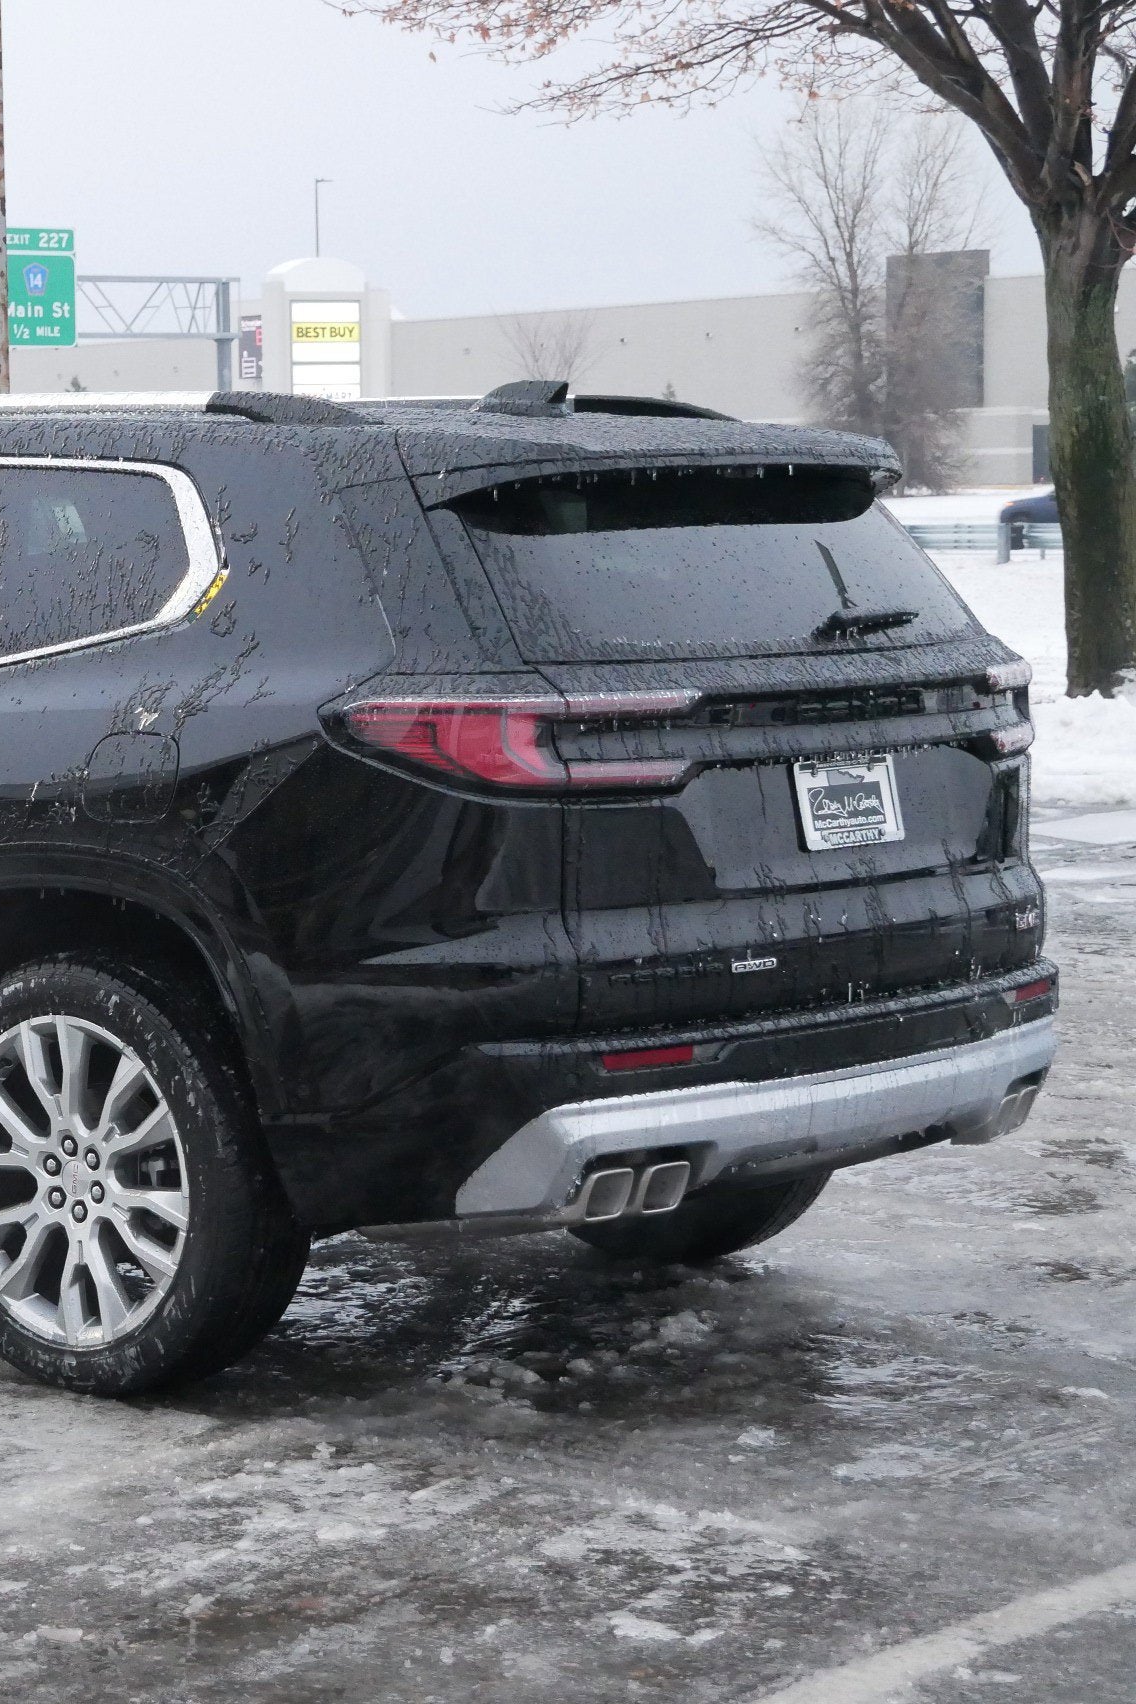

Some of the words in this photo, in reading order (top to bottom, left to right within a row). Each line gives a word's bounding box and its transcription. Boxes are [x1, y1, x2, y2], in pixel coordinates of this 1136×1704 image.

[6, 233, 30, 245] EXIT
[38, 232, 69, 248] 227
[29, 273, 43, 288] 14
[52, 301, 70, 318] St
[36, 326, 61, 337] MILE
[296, 326, 327, 338] BEST
[329, 326, 355, 338] BUY
[814, 815, 884, 829] McCarthyauto.com
[829, 828, 880, 846] MCCARTHY
[734, 959, 775, 972] AWD
